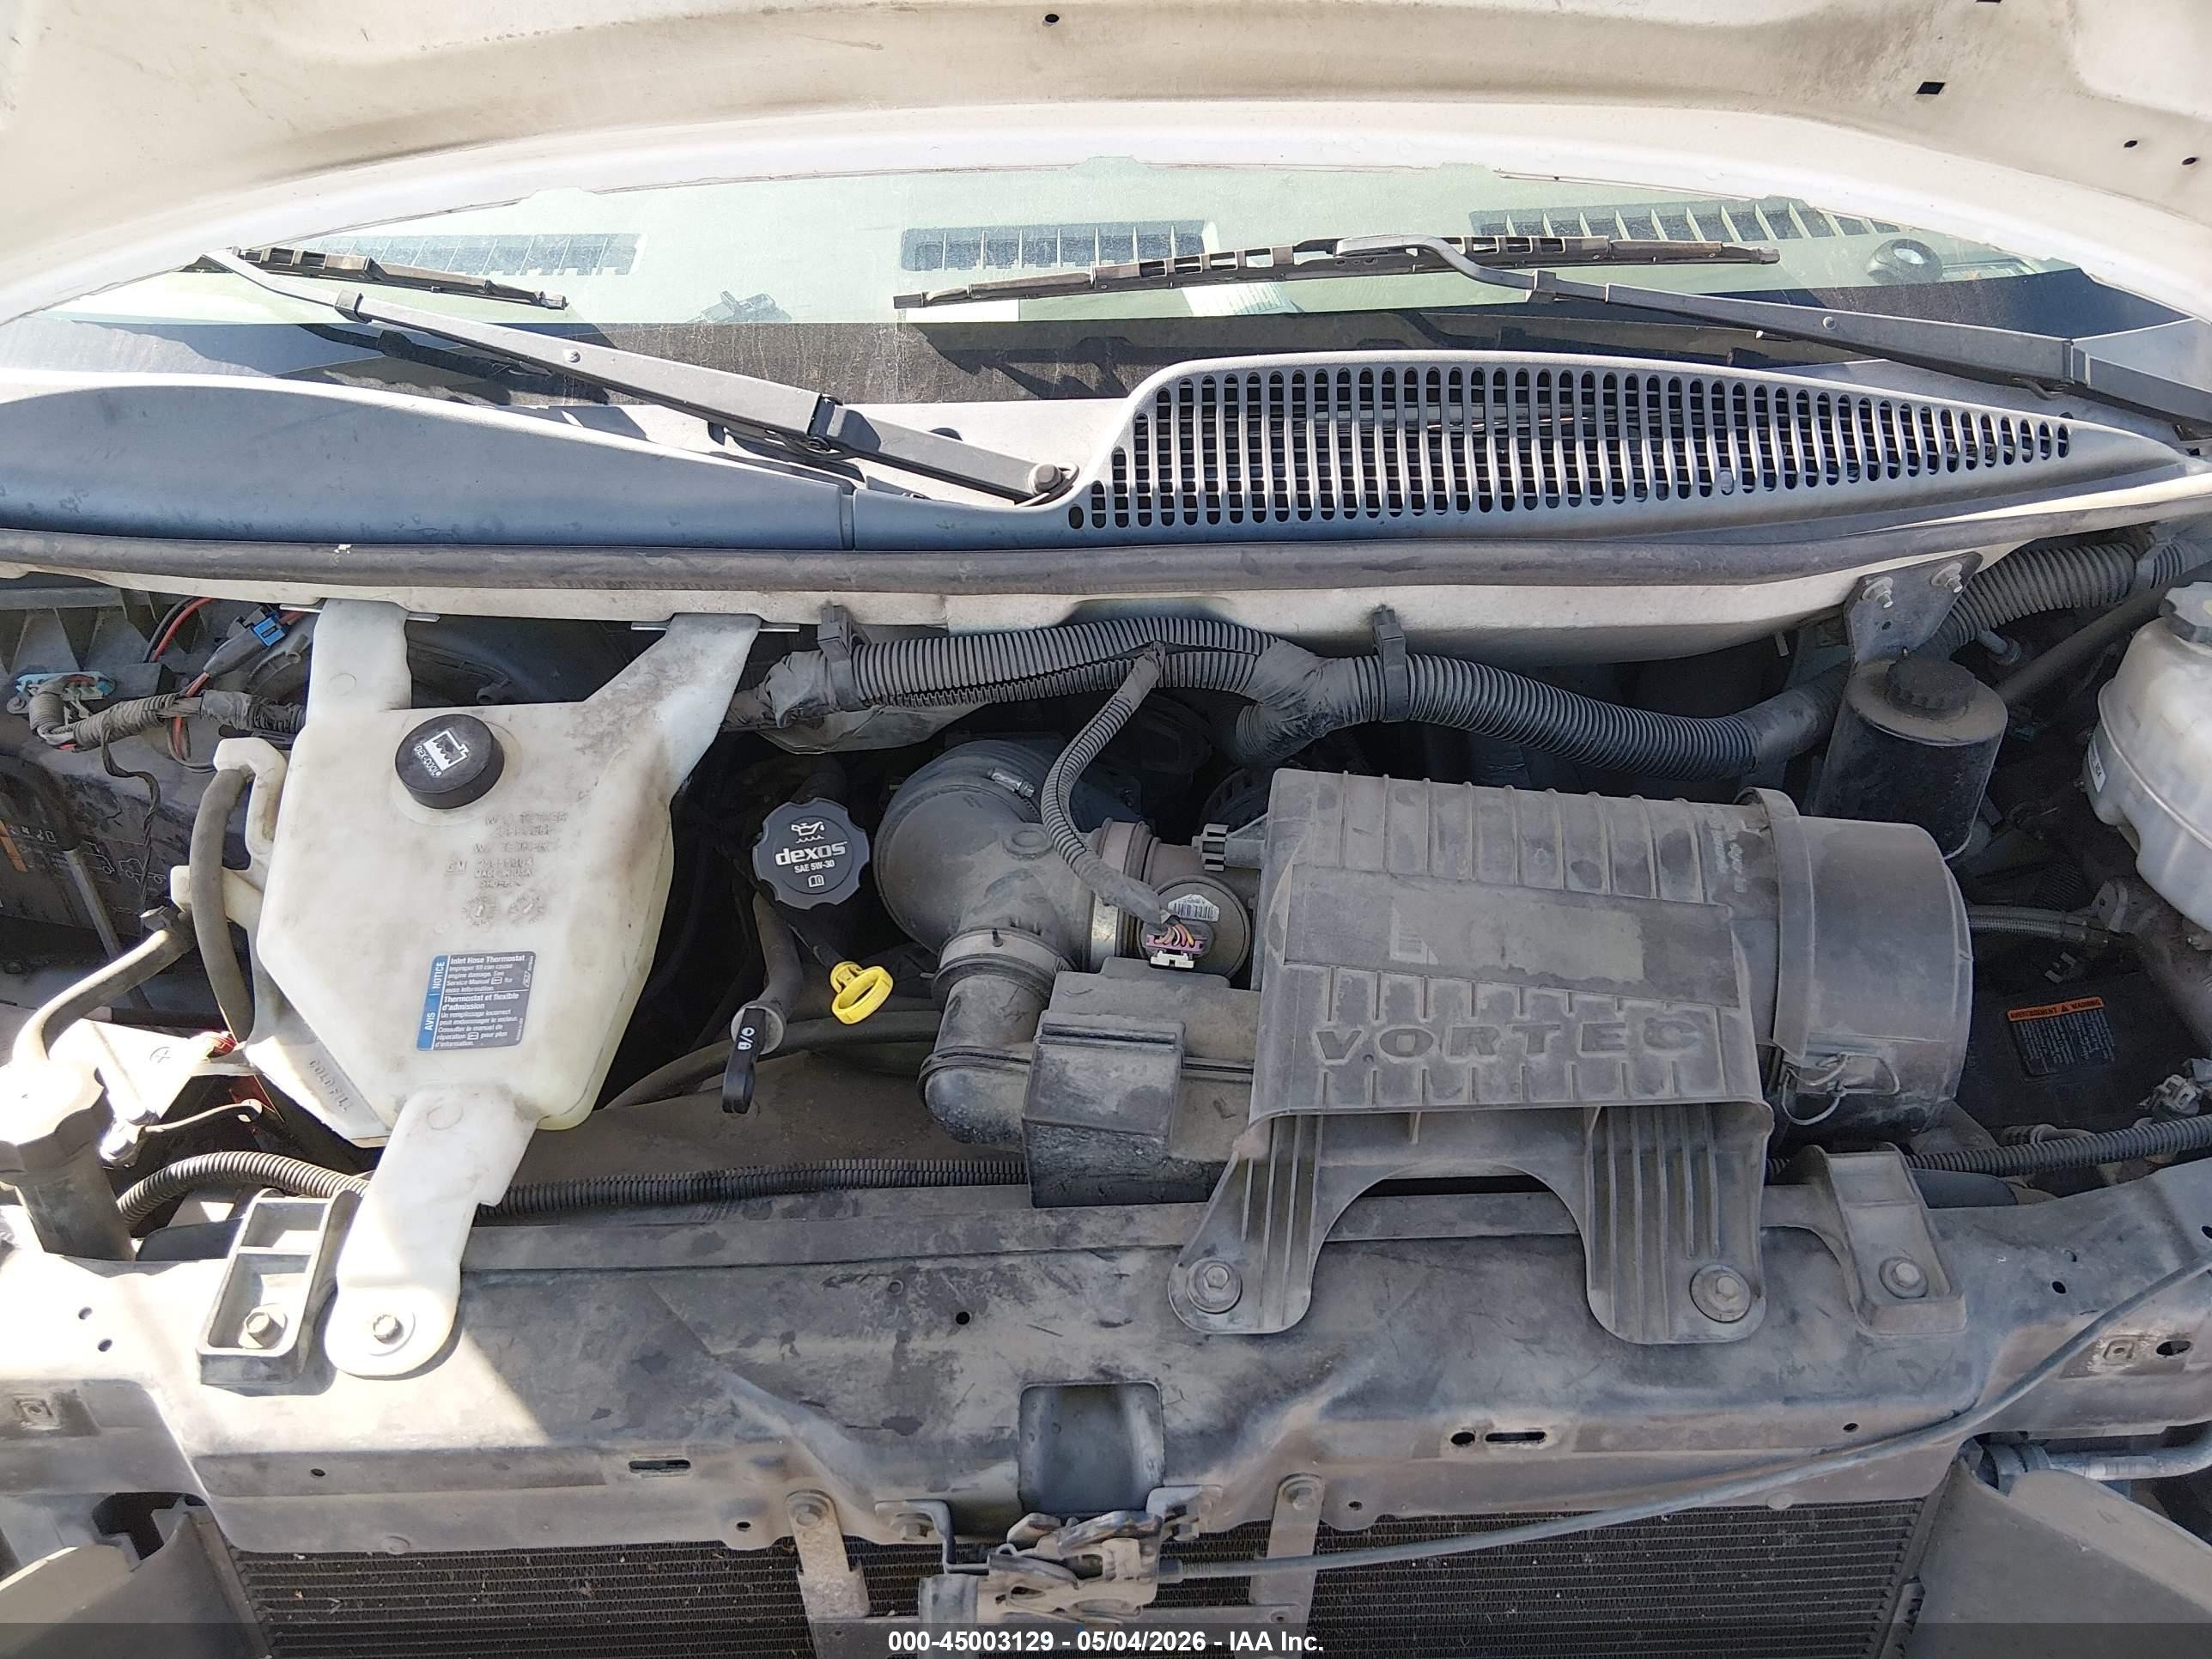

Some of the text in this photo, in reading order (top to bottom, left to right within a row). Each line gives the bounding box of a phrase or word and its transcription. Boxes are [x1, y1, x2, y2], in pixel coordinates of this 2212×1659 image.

[794, 859, 836, 874] SAE 5W-30
[486, 954, 526, 963] Thermostat
[433, 961, 445, 989] NOTICE
[444, 994, 483, 1003] Thermostat
[424, 1012, 436, 1031] AVIS
[1314, 1018, 1698, 1060] VORTEC
